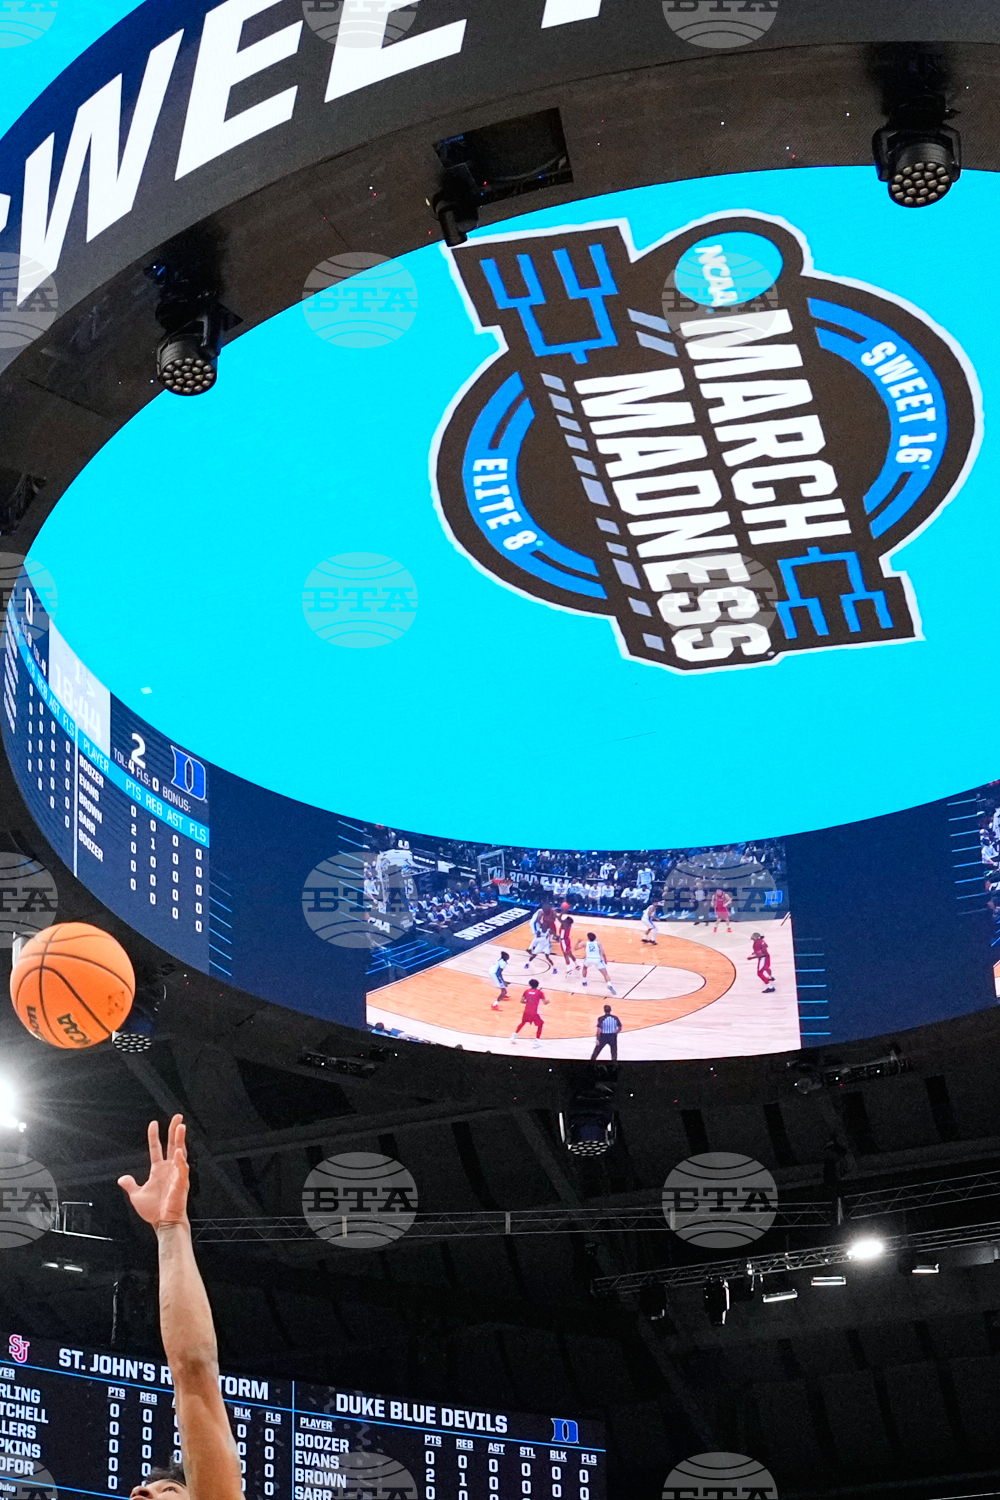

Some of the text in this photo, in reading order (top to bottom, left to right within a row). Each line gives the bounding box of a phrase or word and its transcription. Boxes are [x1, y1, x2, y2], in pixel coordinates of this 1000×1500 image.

[694, 244, 737, 309] NCAA
[680, 308, 852, 545] MARCH
[860, 340, 937, 468] SWEET 16
[473, 457, 538, 551] ELITE 8
[573, 368, 773, 662] MADNESS
[48, 699, 60, 717] AST
[63, 713, 74, 737] FLS
[79, 754, 104, 788] BOOZER
[132, 733, 146, 769] 2
[79, 773, 99, 801] EVANS
[79, 792, 102, 823] BROWN
[84, 738, 206, 843] PLAYER PTS REB AST FLS
[128, 760, 134, 774] 4
[153, 777, 159, 792] 0
[163, 786, 191, 813] BONUS:
[79, 810, 95, 836] SARR
[79, 828, 103, 862] BOOZER
[59, 1348, 86, 1370] ST.
[90, 1354, 155, 1381] JOHN'S
[217, 1375, 269, 1400] TORM
[108, 1386, 125, 1398] PTS
[140, 1392, 157, 1403] REB
[234, 1407, 251, 1418] BLK
[266, 1412, 281, 1423] FLS
[336, 1393, 507, 1433] DUKE BLUE DEVILS
[295, 1433, 588, 1483] BOOZER 0 0 0 0 0 0
[301, 1417, 597, 1463] PLAYER PTS REB AST STL BLK FLS
[295, 1450, 589, 1500] EVANS 2 1 0 0 0 0
[295, 1468, 346, 1488] BROWN
